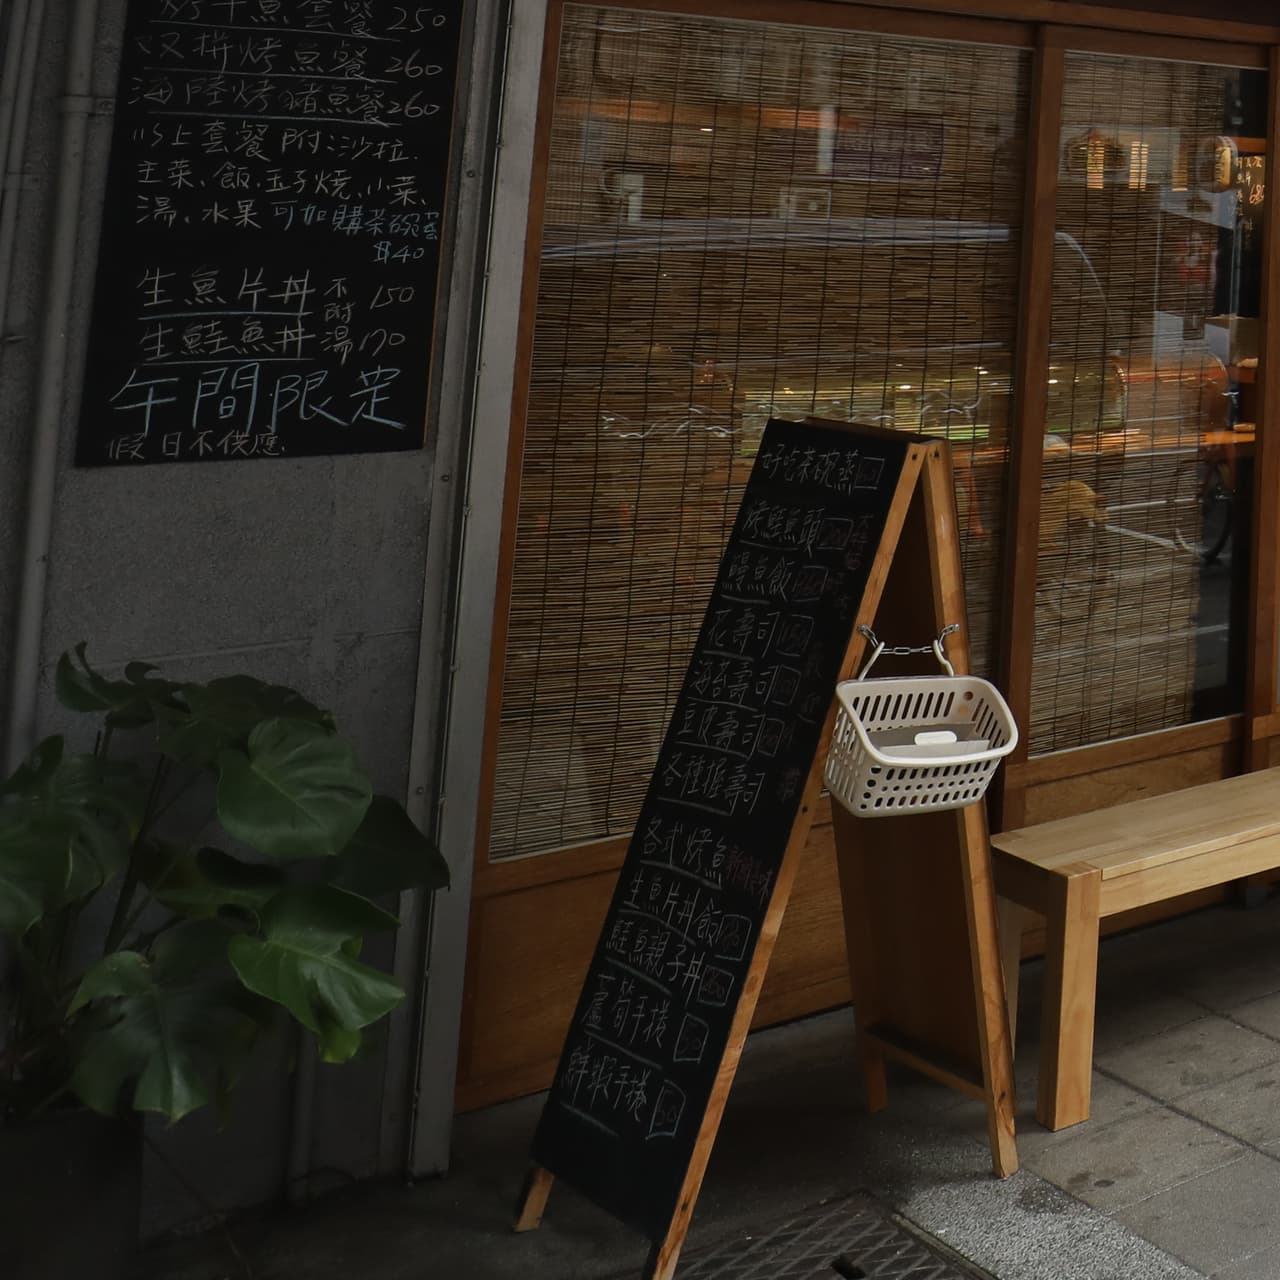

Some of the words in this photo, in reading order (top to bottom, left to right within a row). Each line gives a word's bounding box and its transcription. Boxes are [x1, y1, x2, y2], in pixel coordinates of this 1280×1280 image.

[386, 5, 448, 34] 250
[384, 49, 444, 78] 260
[386, 90, 441, 119] 260
[369, 285, 415, 311] 150
[108, 361, 408, 437] 午間限定
